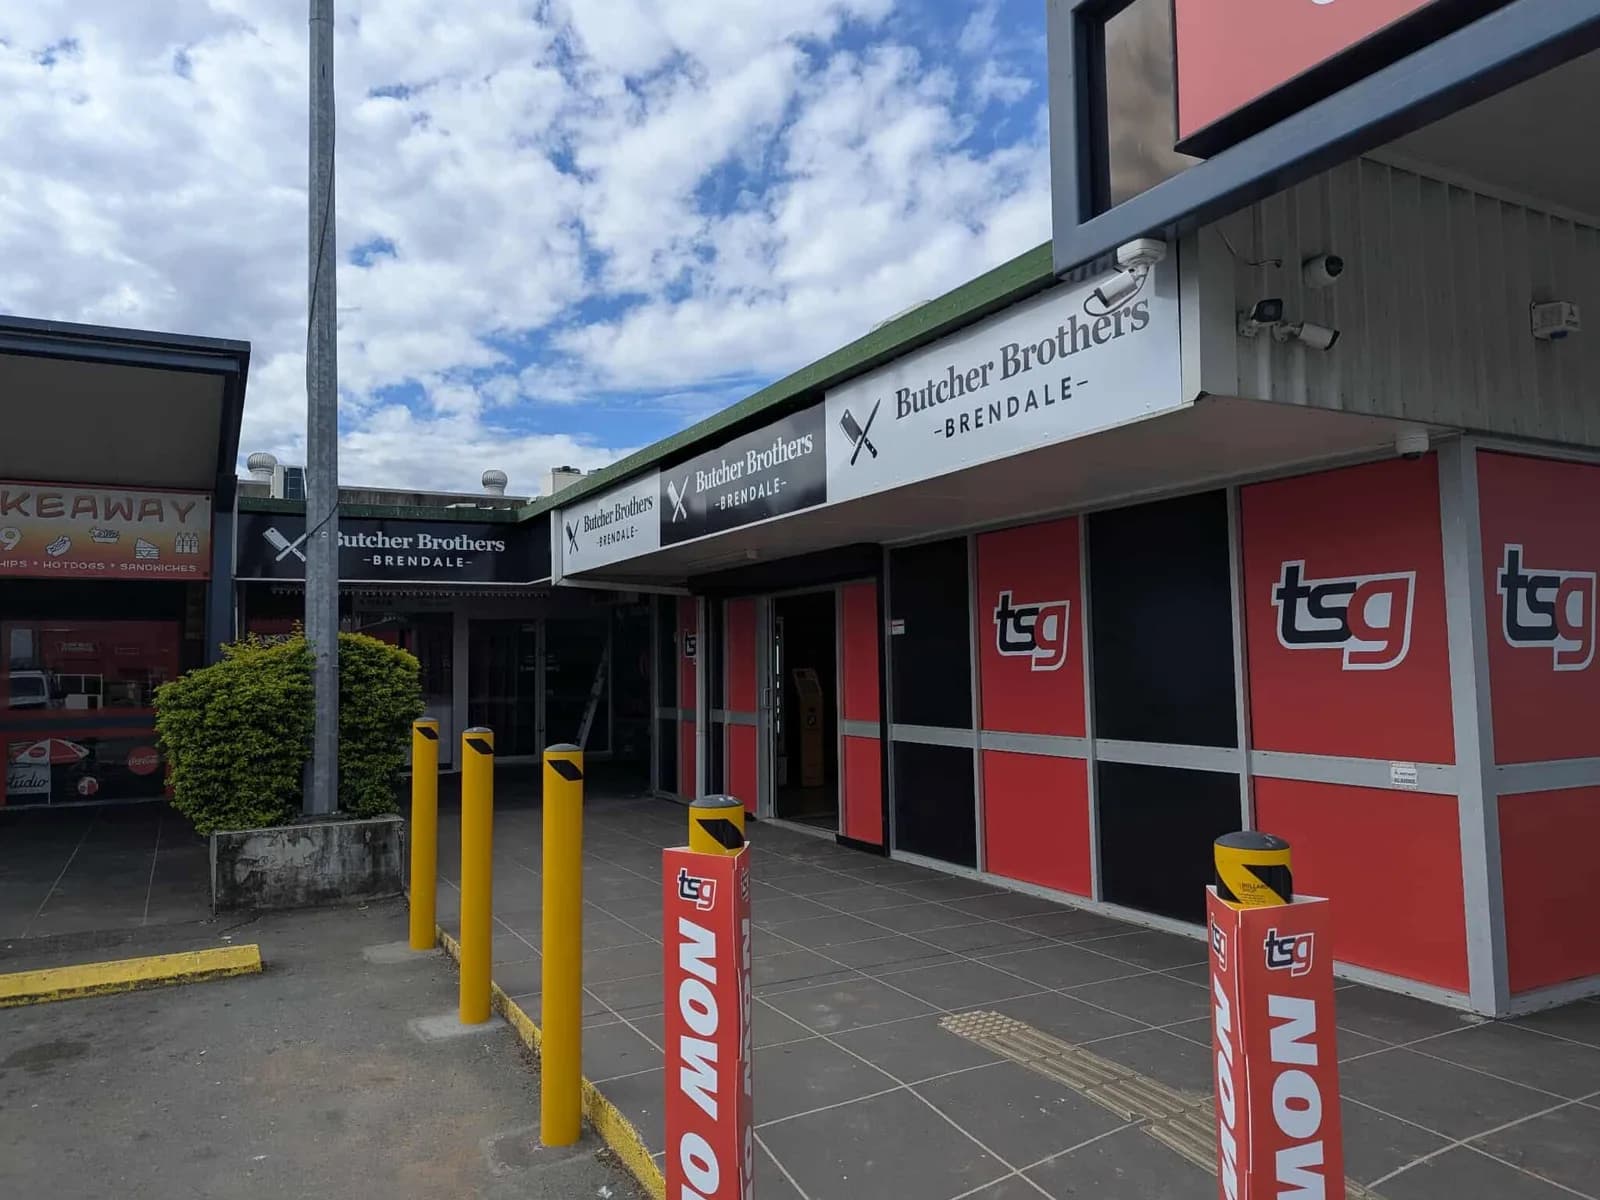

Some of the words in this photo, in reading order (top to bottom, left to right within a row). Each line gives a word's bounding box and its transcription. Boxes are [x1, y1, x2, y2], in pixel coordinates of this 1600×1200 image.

[895, 360, 994, 420] Butcher
[999, 298, 1150, 381] Brothers
[695, 459, 746, 494] Butcher
[746, 433, 814, 476] Brothers
[416, 533, 506, 552] Brothers
[583, 509, 615, 533] Butcher
[615, 493, 654, 522] Brothers
[42, 560, 106, 571] HOTDOGS
[120, 562, 198, 573] SANDWICHES
[993, 590, 1071, 672] tsg
[1271, 560, 1416, 671] tsg
[1497, 543, 1597, 672] tsg
[677, 867, 717, 911] tsg
[1264, 928, 1314, 977] tsg
[679, 917, 719, 1121] NOW
